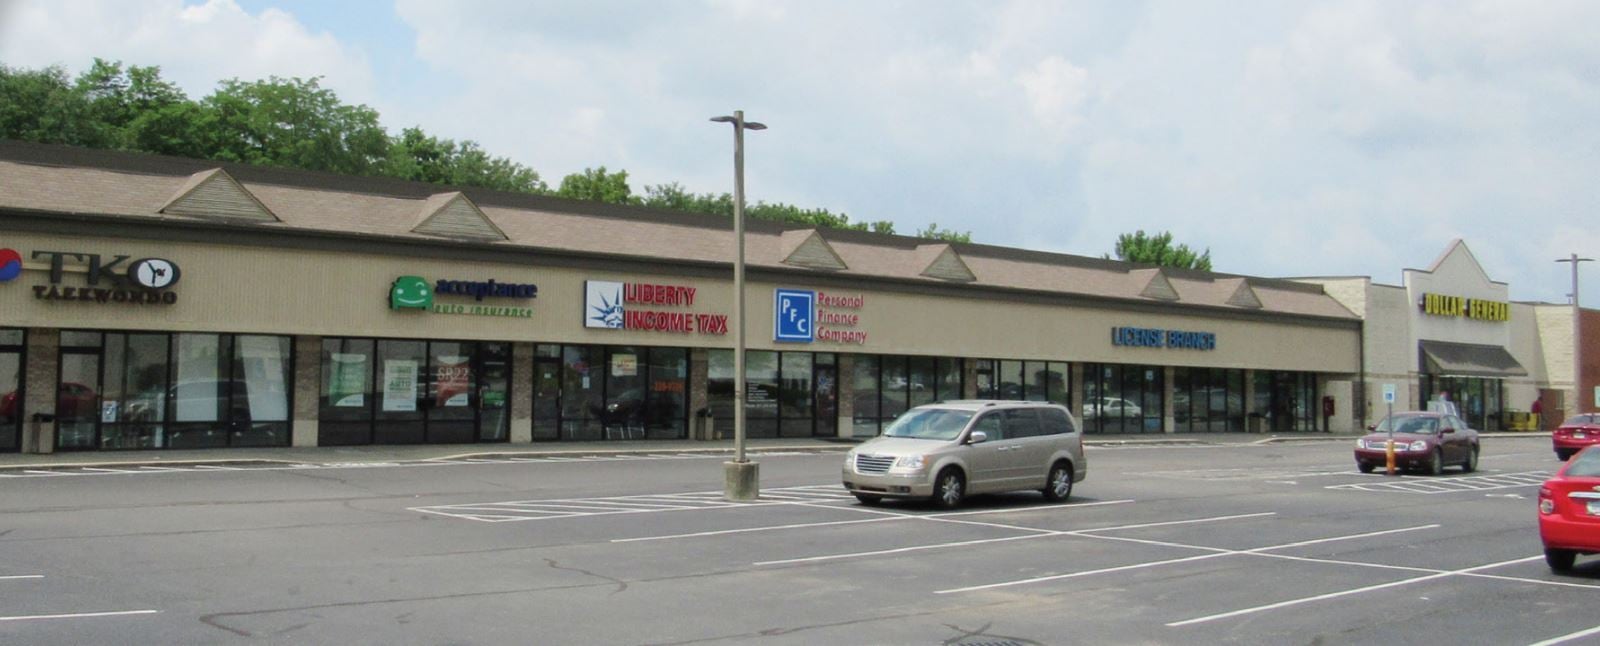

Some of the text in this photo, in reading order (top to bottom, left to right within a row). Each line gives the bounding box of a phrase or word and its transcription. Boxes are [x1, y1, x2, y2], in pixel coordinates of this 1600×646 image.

[32, 250, 181, 288] TKO
[32, 286, 177, 304] TAEKWONDO
[435, 279, 537, 301] acceptance
[624, 283, 696, 306] LIBERTY
[817, 291, 864, 308] Personal
[434, 304, 533, 317] auto insurance
[817, 309, 859, 325] Finance
[1423, 293, 1511, 322] DOLLAR GENERAL
[624, 310, 728, 335] INCOME TAX
[817, 326, 868, 344] Company
[1111, 326, 1216, 351] LICENSE BRANCH
